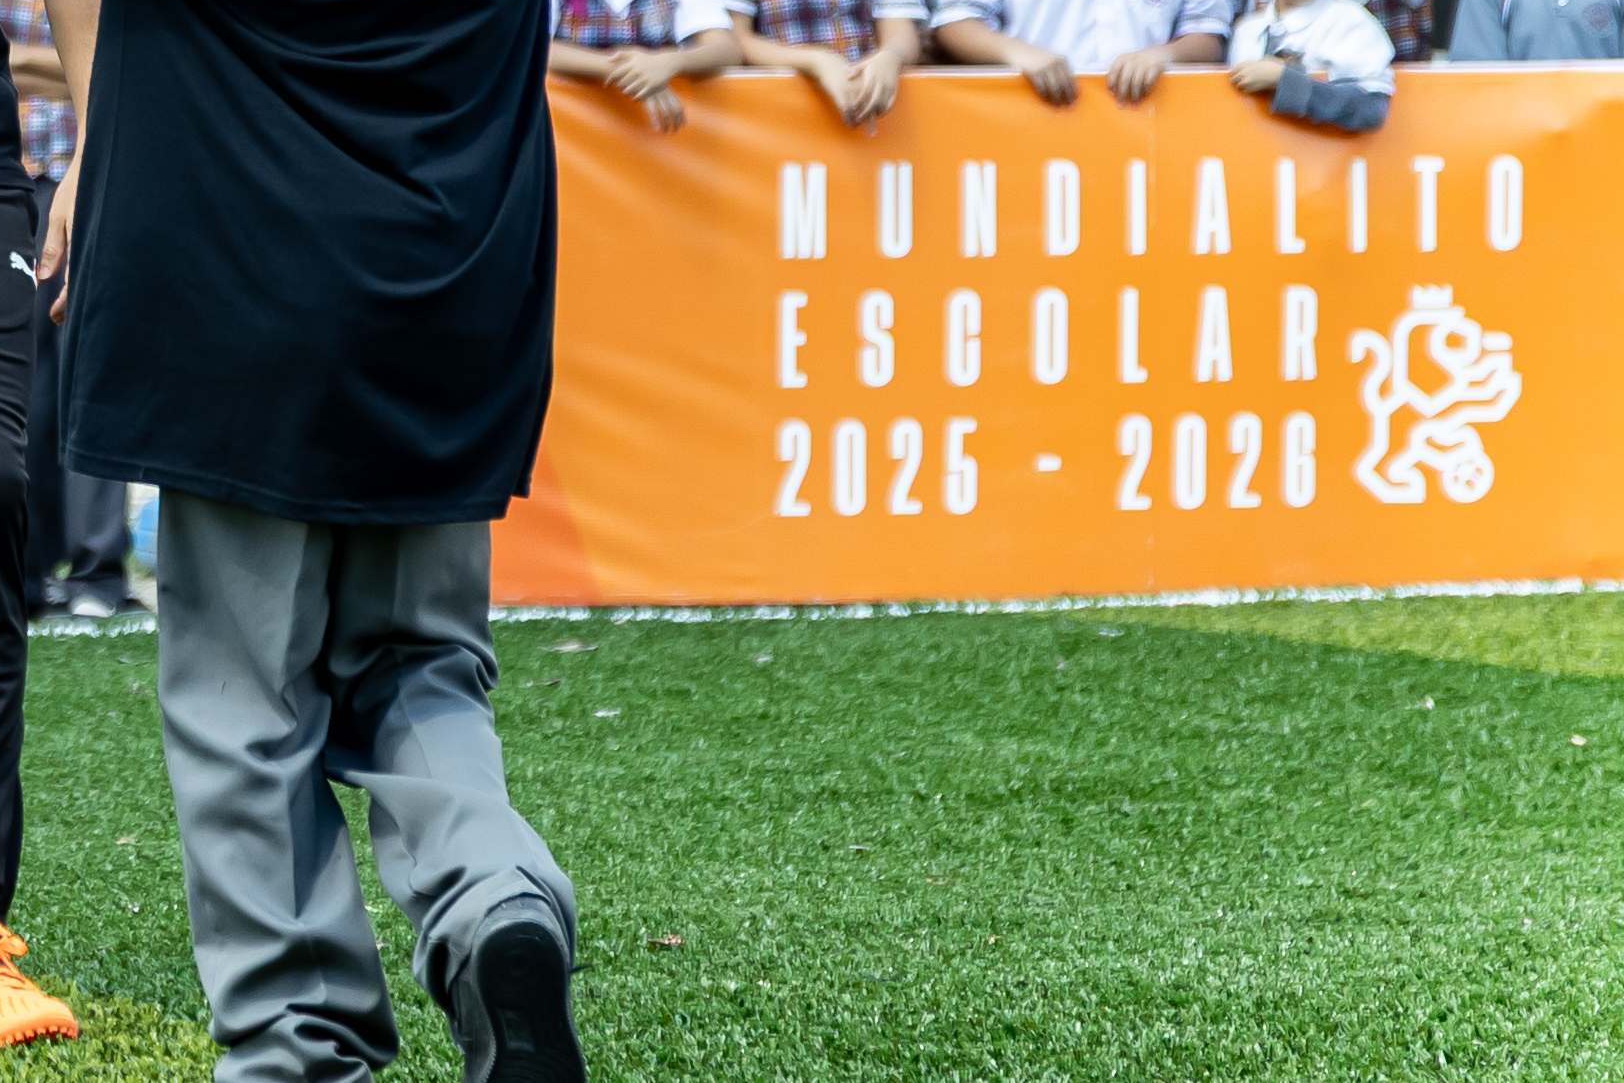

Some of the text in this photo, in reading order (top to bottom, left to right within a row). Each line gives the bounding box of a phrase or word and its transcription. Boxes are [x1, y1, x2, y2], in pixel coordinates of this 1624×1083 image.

[777, 154, 1524, 260] MUNDIALITO
[776, 284, 1319, 389] ESCOLAR
[772, 411, 1318, 518] 2025 - 2026
